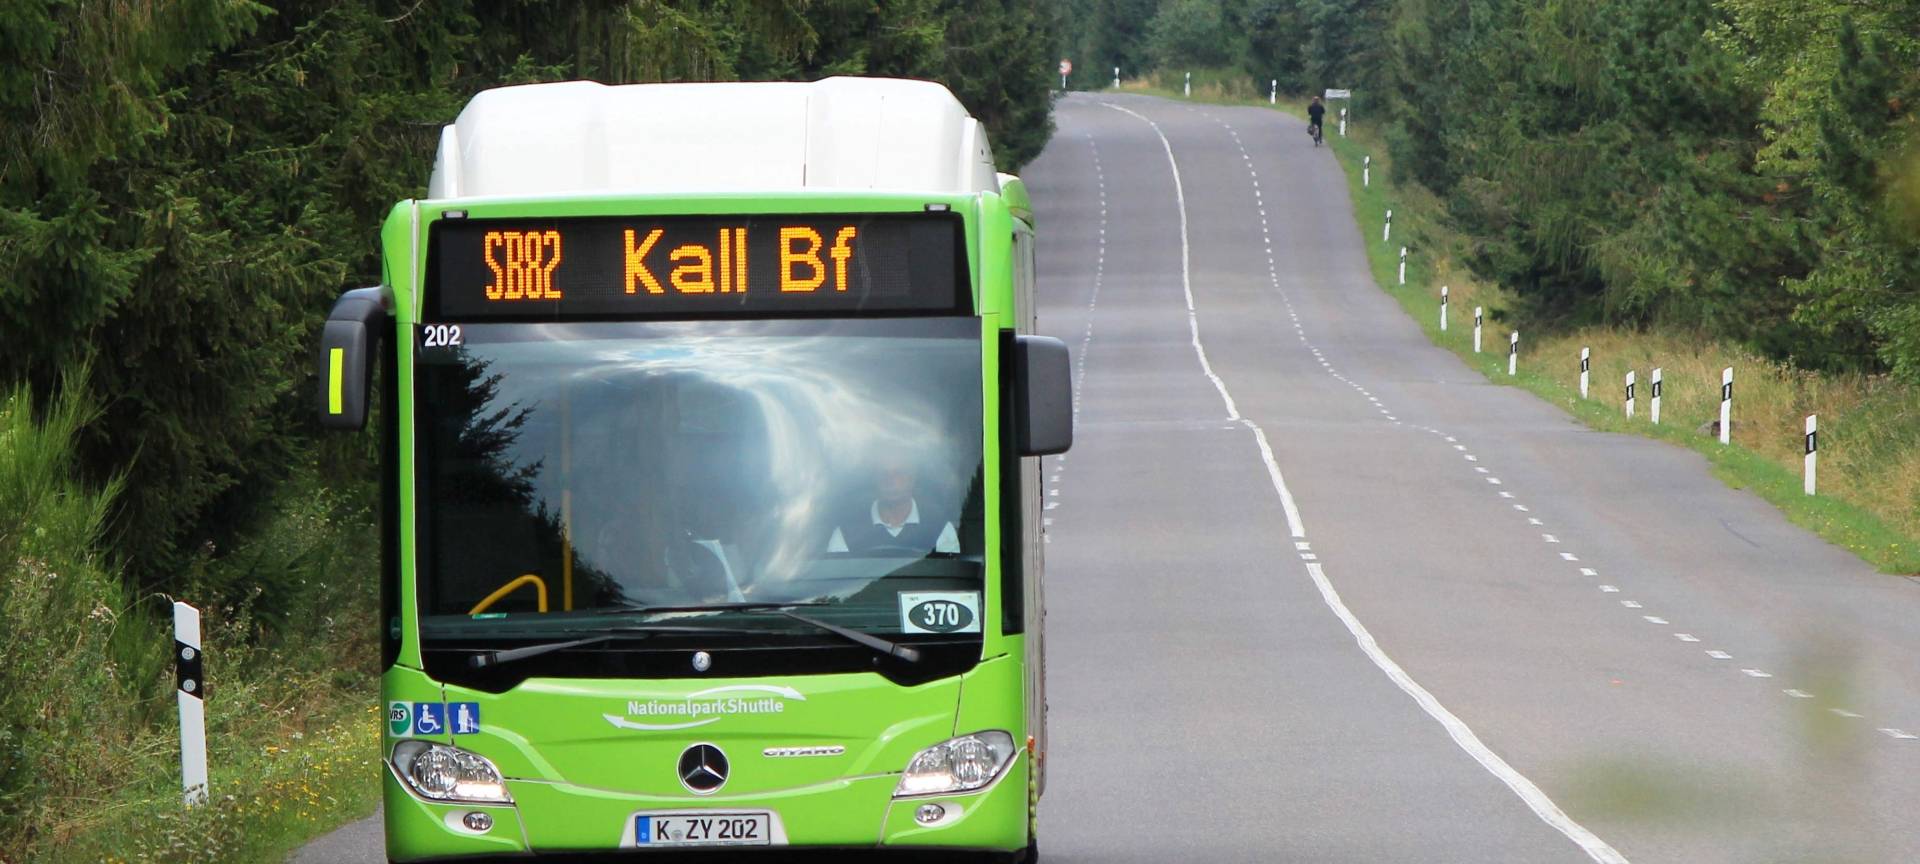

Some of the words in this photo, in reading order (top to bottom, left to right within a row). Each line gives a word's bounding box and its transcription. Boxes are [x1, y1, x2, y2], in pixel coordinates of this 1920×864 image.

[484, 230, 562, 300] SB82
[623, 226, 747, 294] Kall
[779, 225, 857, 293] Bf
[424, 324, 461, 347] 202
[923, 603, 960, 626] 370
[656, 820, 670, 841] K
[686, 819, 713, 840] ZY
[718, 818, 758, 840] 202
